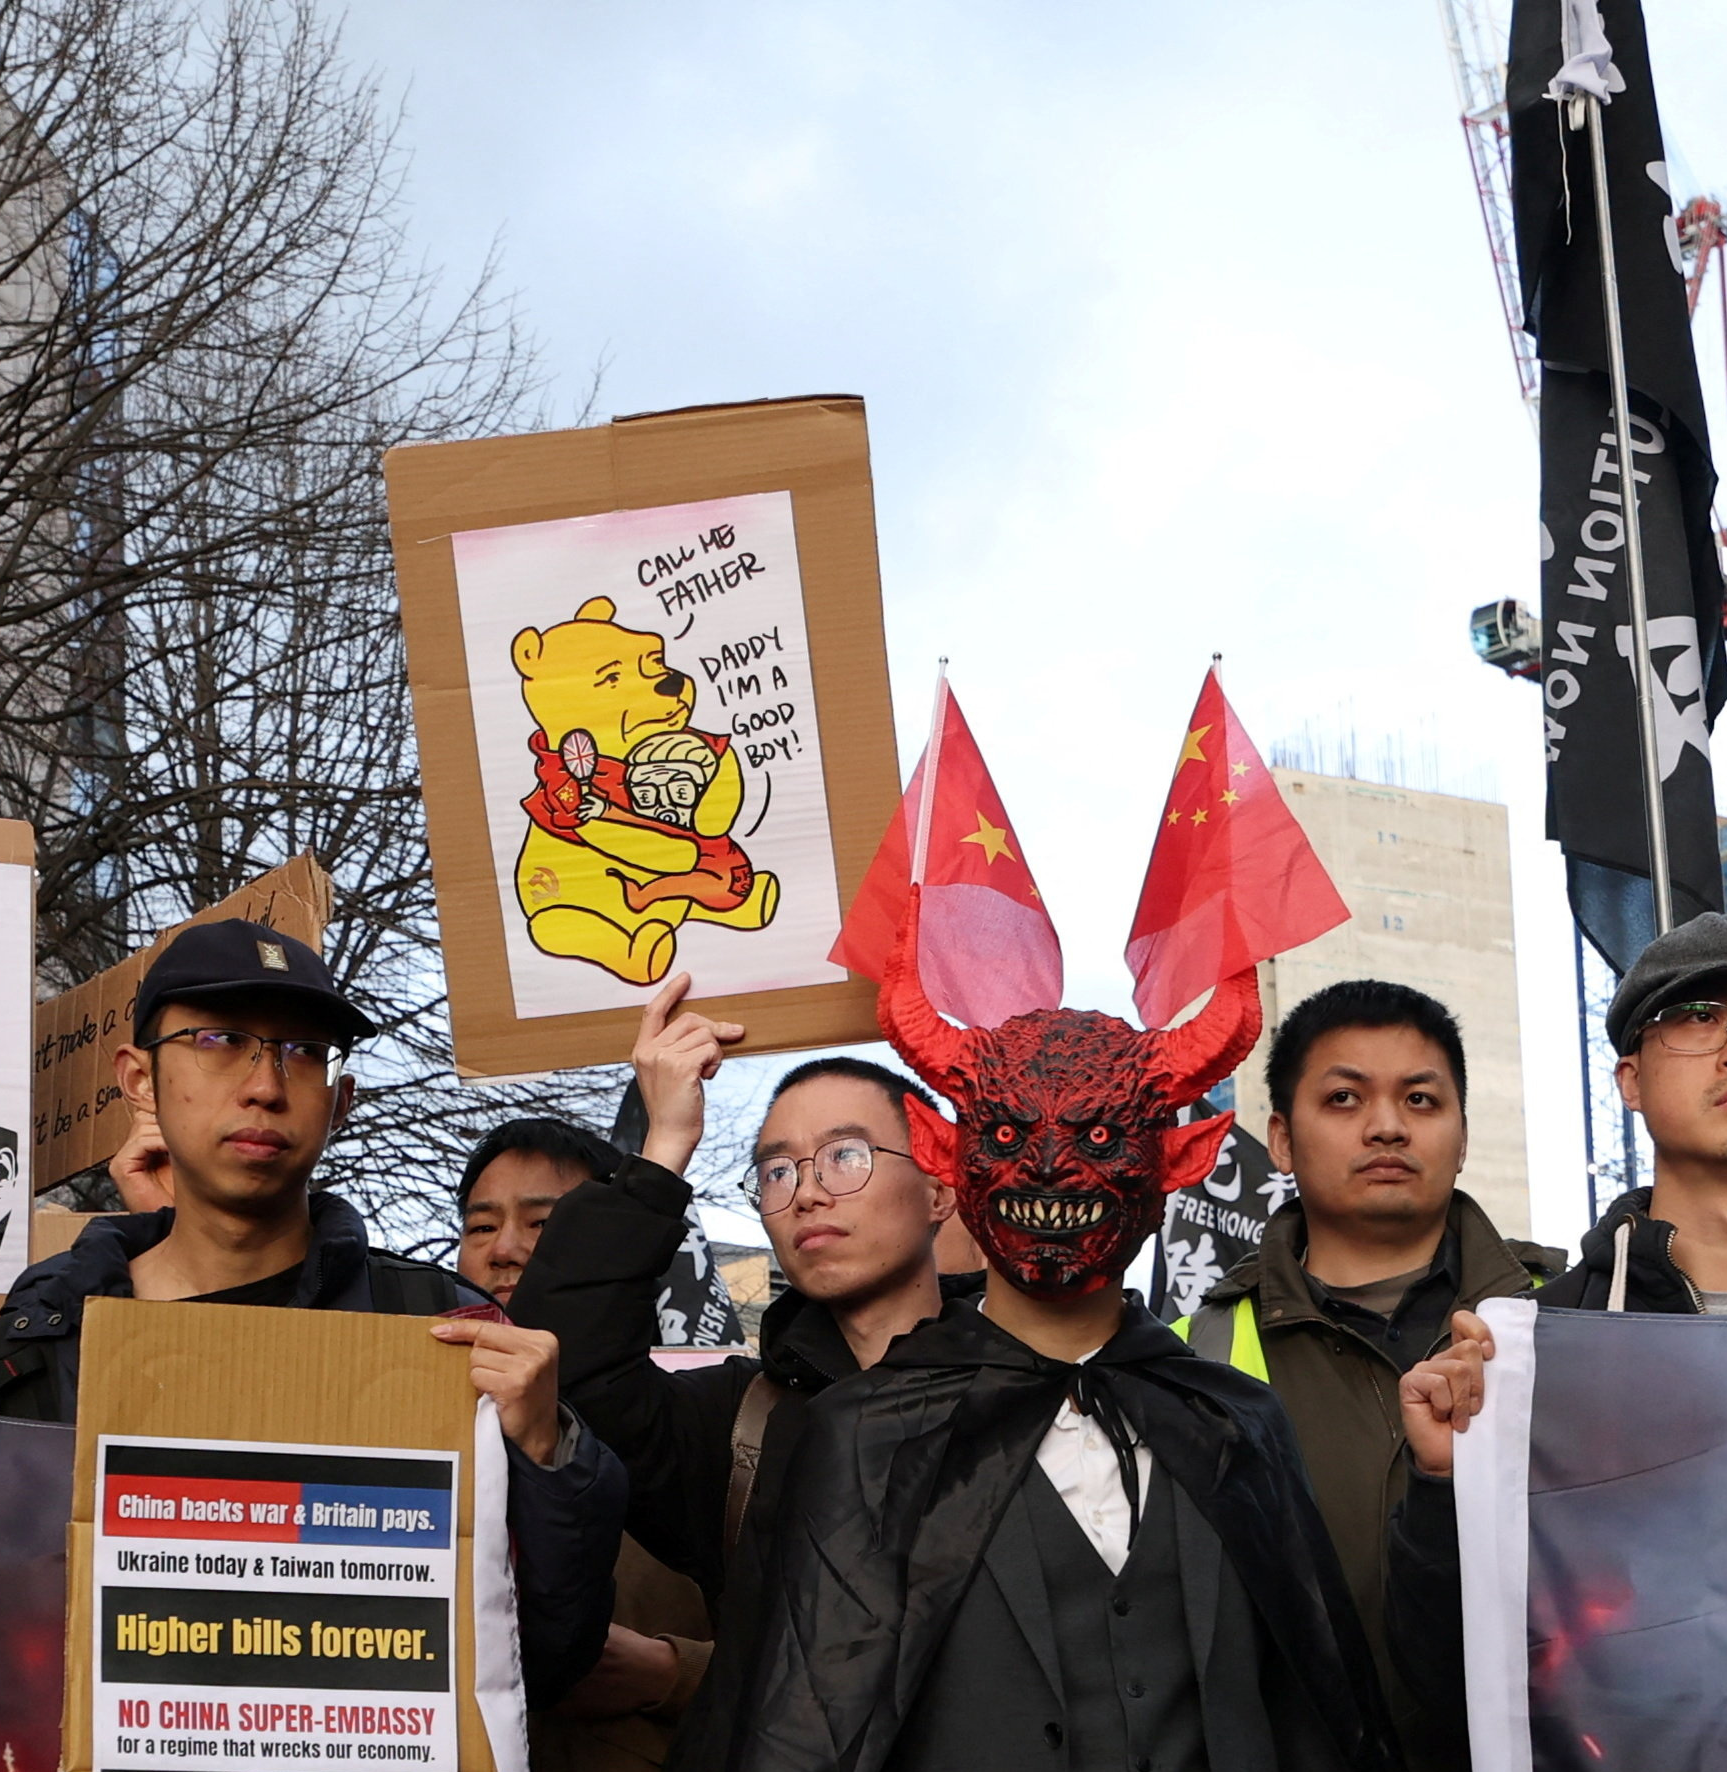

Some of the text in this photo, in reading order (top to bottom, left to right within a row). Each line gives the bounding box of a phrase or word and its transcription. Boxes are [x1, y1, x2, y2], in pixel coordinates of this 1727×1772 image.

[638, 524, 735, 586] CALL ME
[657, 552, 765, 616] FATHER
[699, 626, 783, 683] DADDY
[717, 665, 788, 706] I'M A
[732, 702, 795, 738] GOOD
[745, 729, 802, 769] BOY!
[58, 1013, 98, 1063] make
[103, 1009, 117, 1036] a
[53, 1098, 72, 1139] be
[77, 1102, 90, 1122] a
[118, 1495, 435, 1532] China backs war & Britain pays.
[118, 1551, 435, 1583] Ukraine today & Taiwan tomorrow.
[117, 1613, 435, 1661] Higher bills forever.
[119, 1699, 435, 1735] NO CHINA SUPER-EMBASSY
[117, 1736, 435, 1763] for a regime that wrecks our economy.
